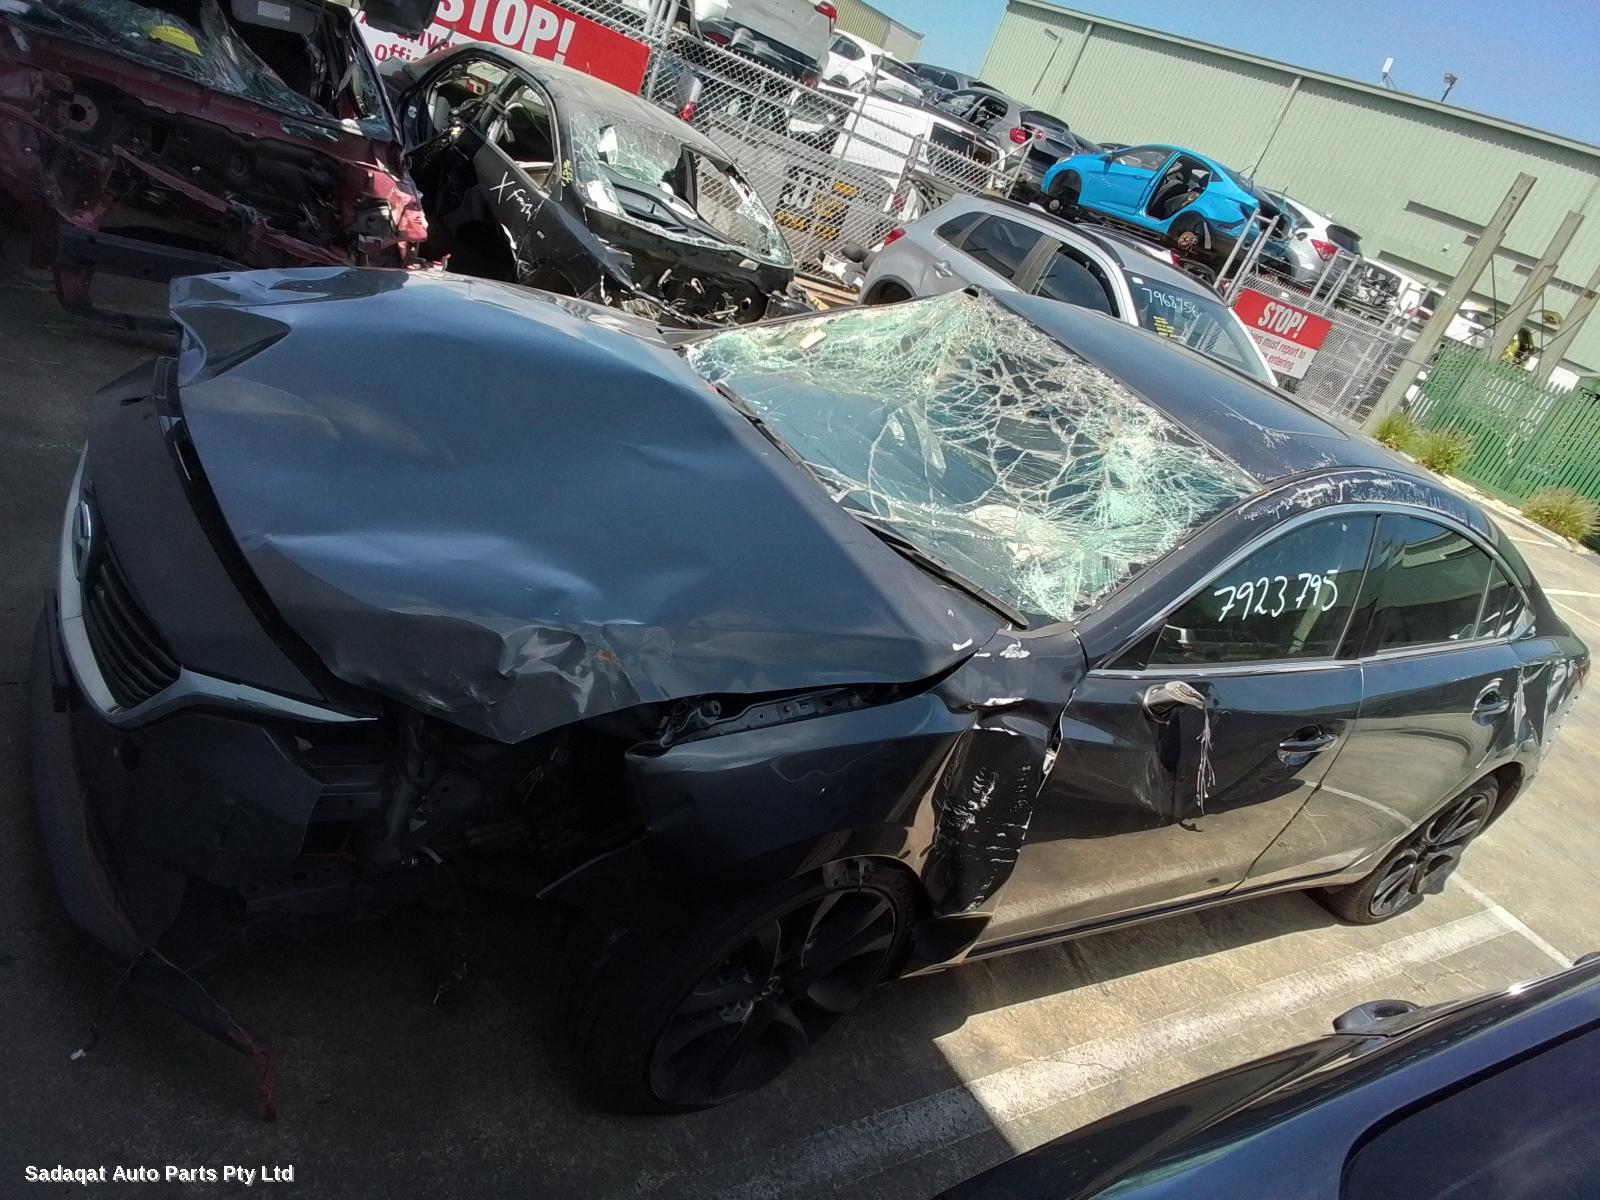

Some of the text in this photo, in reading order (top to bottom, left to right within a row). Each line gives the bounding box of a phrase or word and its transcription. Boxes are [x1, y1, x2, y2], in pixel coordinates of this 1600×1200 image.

[374, 44, 420, 62] Offi
[1141, 287, 1200, 319] 7968756
[1257, 301, 1309, 339] STOP!
[1262, 337, 1280, 351] must
[1280, 344, 1300, 358] report
[1298, 349, 1306, 360] to
[1267, 352, 1295, 373] entering
